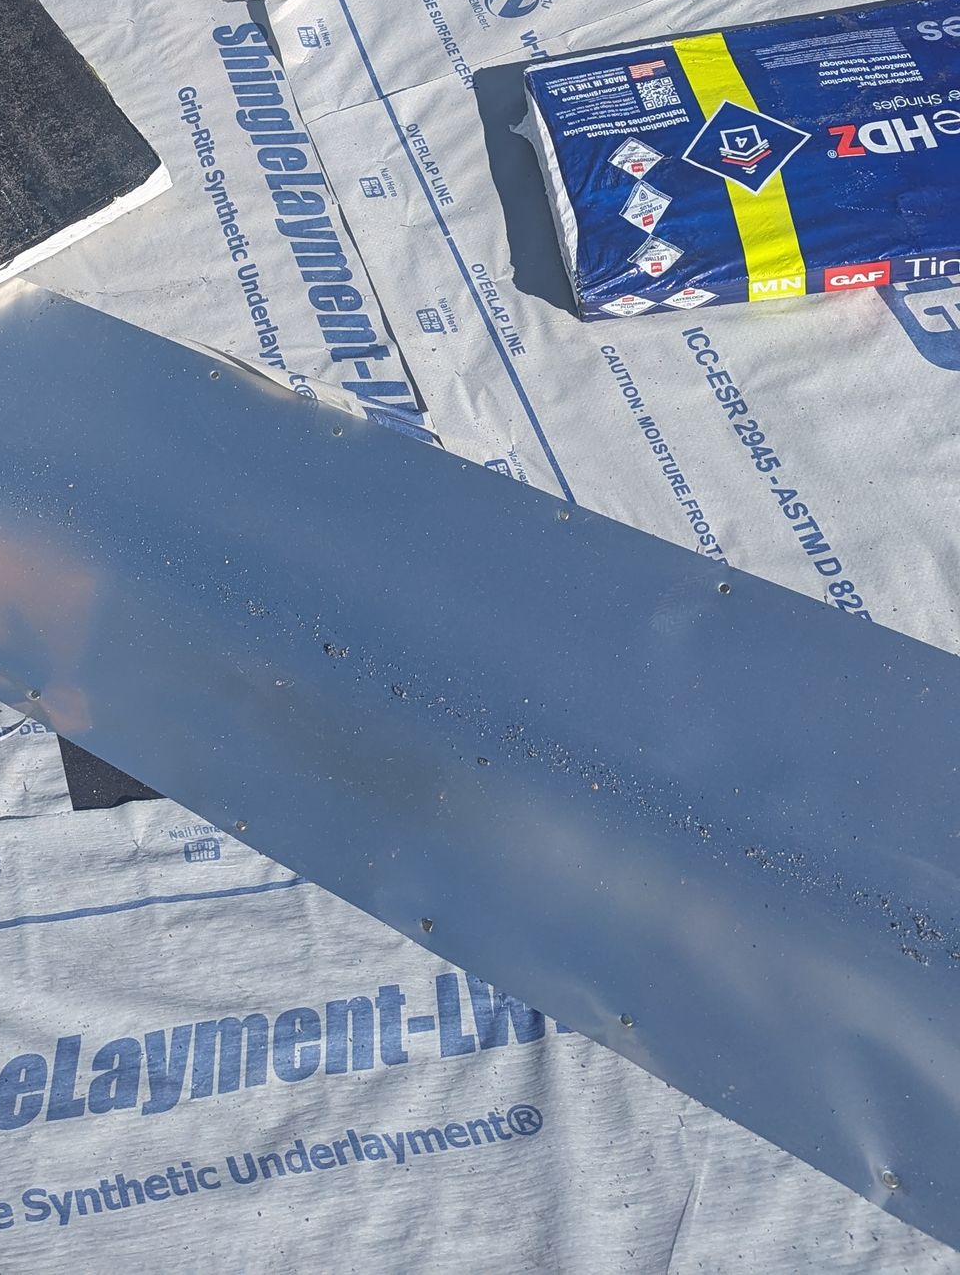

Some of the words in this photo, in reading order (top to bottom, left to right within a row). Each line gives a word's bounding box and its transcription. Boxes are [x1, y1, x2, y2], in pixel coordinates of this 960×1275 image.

[430, 10, 460, 56] SURFACE
[819, 56, 866, 68] Technology
[840, 65, 870, 74] Nailing
[604, 75, 628, 84] MADE
[865, 73, 889, 81] Algae
[878, 75, 923, 86] StainGuard
[548, 85, 575, 96] U.S.A.
[576, 82, 591, 91] THE
[872, 93, 942, 111] Shingles
[627, 108, 687, 125] Instrucciones
[640, 116, 689, 132] Installation
[587, 125, 639, 138] instructions
[735, 137, 748, 148] 4
[404, 122, 439, 181] OVERLAP
[430, 178, 454, 207] LINE
[178, 85, 217, 169] Grip-Rite
[205, 168, 252, 263] Synthetic
[380, 167, 390, 182] Nail
[385, 181, 397, 198] Here
[751, 276, 802, 296] MN
[830, 270, 885, 286] GAF
[439, 297, 449, 312] Nail
[445, 311, 458, 333] Here
[470, 262, 511, 324] OVERLAP
[502, 319, 526, 357] LINE
[600, 345, 644, 414] CAUTION:
[682, 326, 748, 420] ICC-ESR
[733, 419, 782, 473] 2945
[770, 487, 831, 556] ASTM
[814, 557, 842, 577] D
[168, 827, 192, 842] Nail
[21, 1155, 222, 1228] Synthetic
[226, 1102, 545, 1187] Underlayment®
